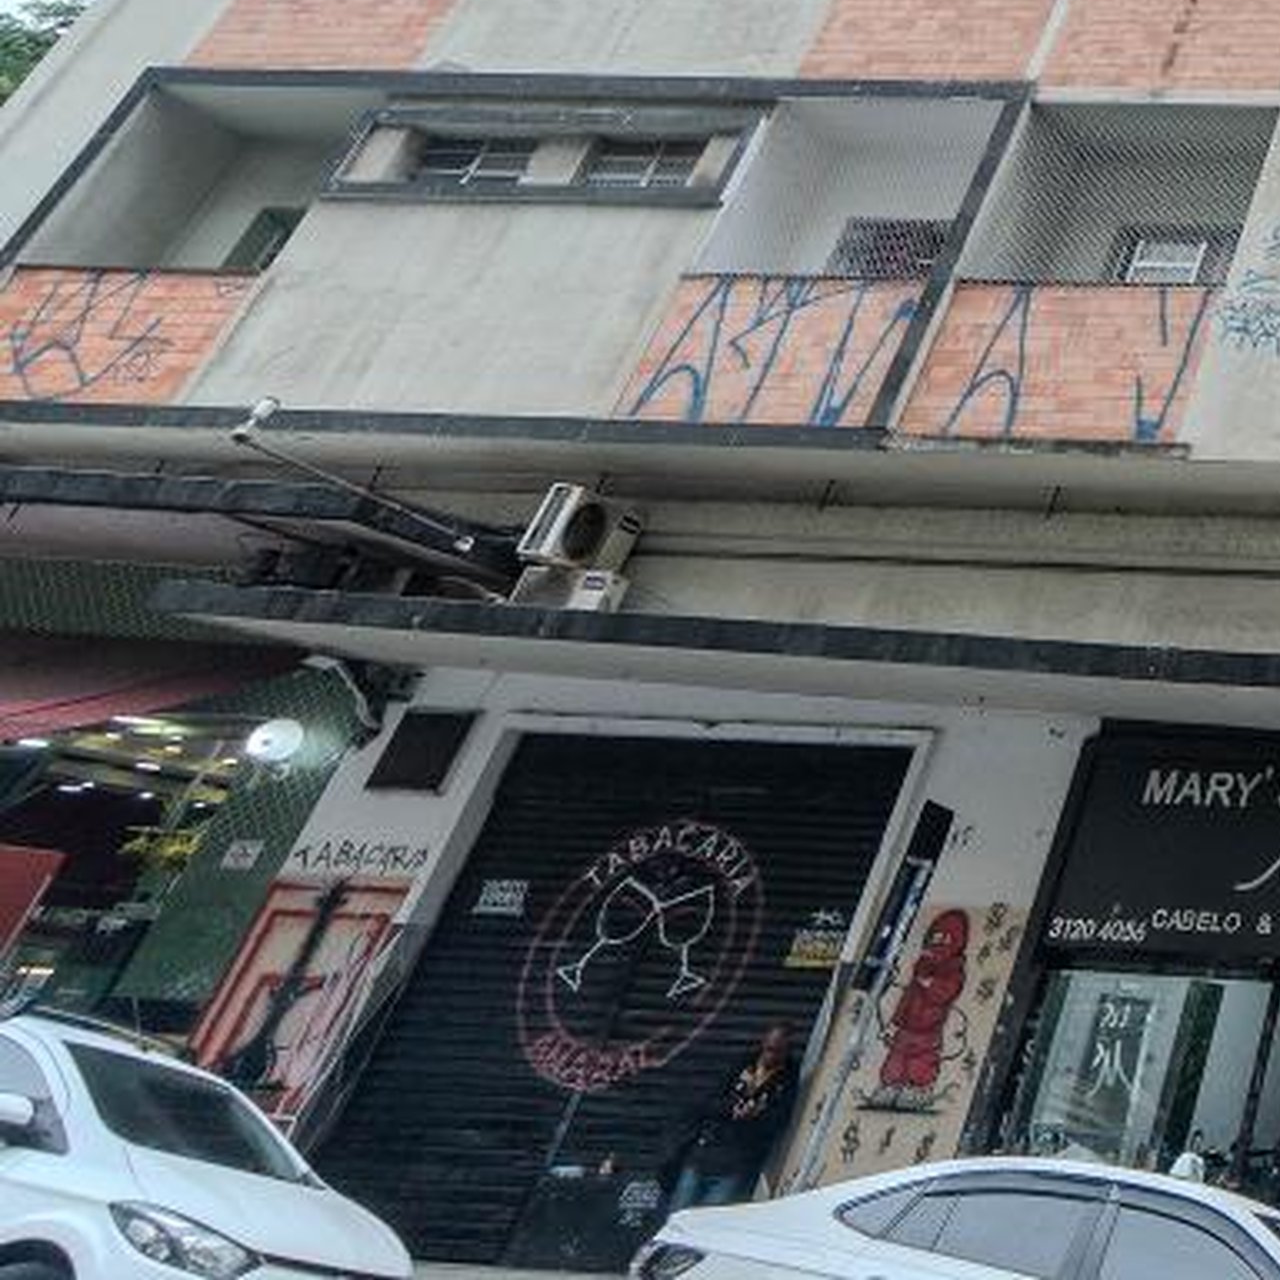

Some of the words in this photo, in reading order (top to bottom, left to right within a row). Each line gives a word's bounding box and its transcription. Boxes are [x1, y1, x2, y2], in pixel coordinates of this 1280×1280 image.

[581, 823, 755, 898] TABACARIA
[1048, 916, 1096, 941] 3120
[1151, 908, 1243, 933] CABELO
[1255, 913, 1272, 935] &
